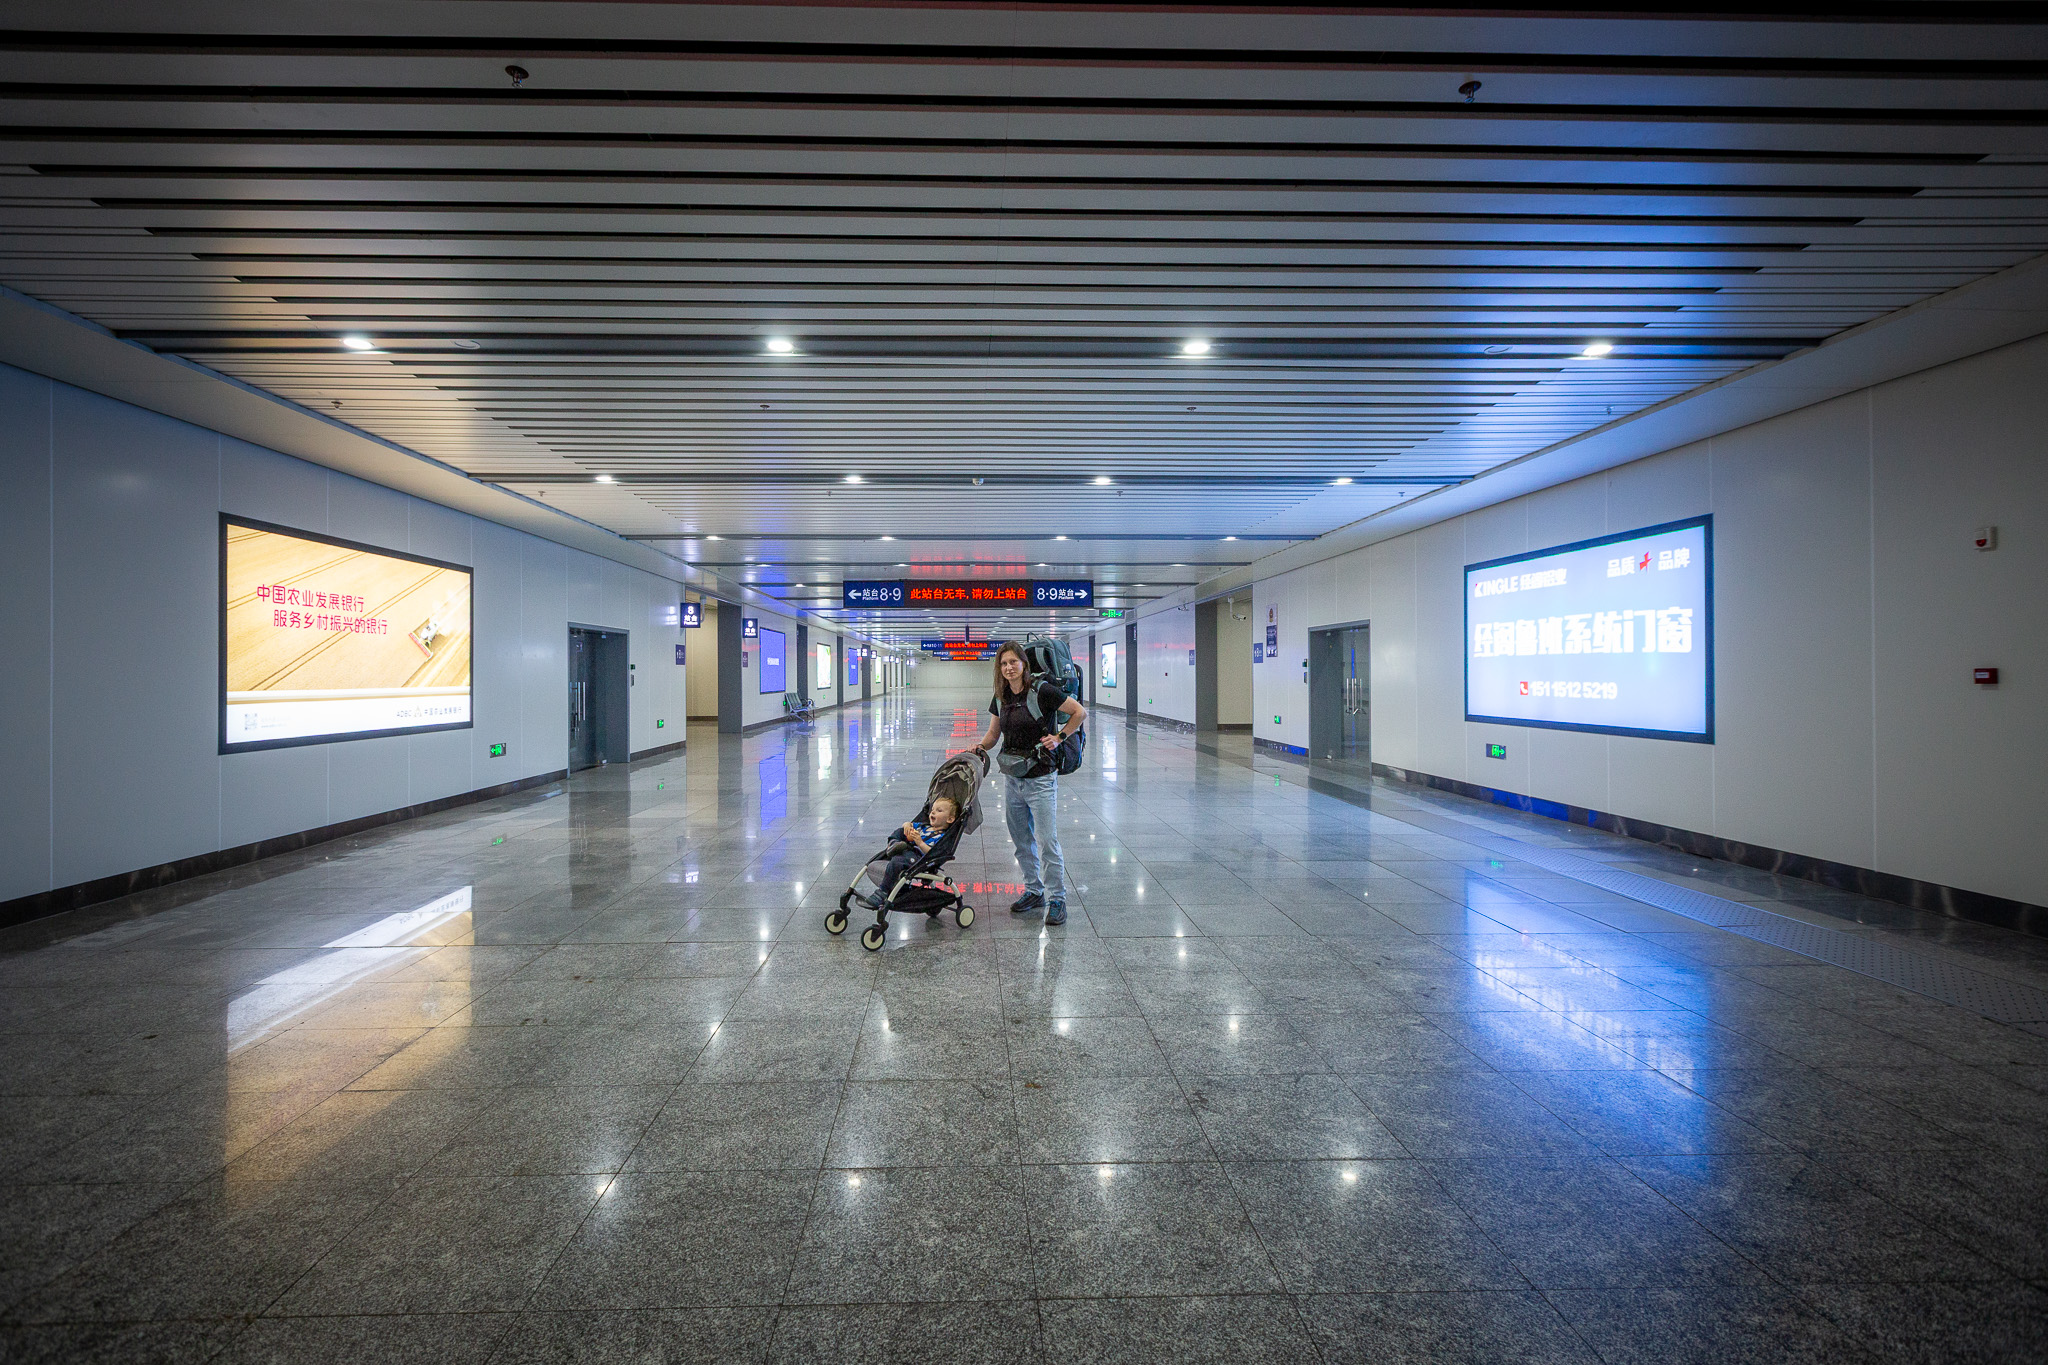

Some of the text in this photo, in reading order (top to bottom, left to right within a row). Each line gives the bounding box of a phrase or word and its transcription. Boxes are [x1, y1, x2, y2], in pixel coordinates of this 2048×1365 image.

[1606, 547, 1691, 578] 品质 品牌
[862, 588, 879, 597] 站台
[1058, 588, 1075, 597] 站台
[1474, 575, 1518, 598] KINGLE
[256, 583, 364, 613] 中国农业发展银行
[687, 605, 695, 615] 8
[273, 609, 388, 635] 服务乡村振兴的银行
[747, 620, 754, 628] 9
[1582, 682, 1618, 700] 5219
